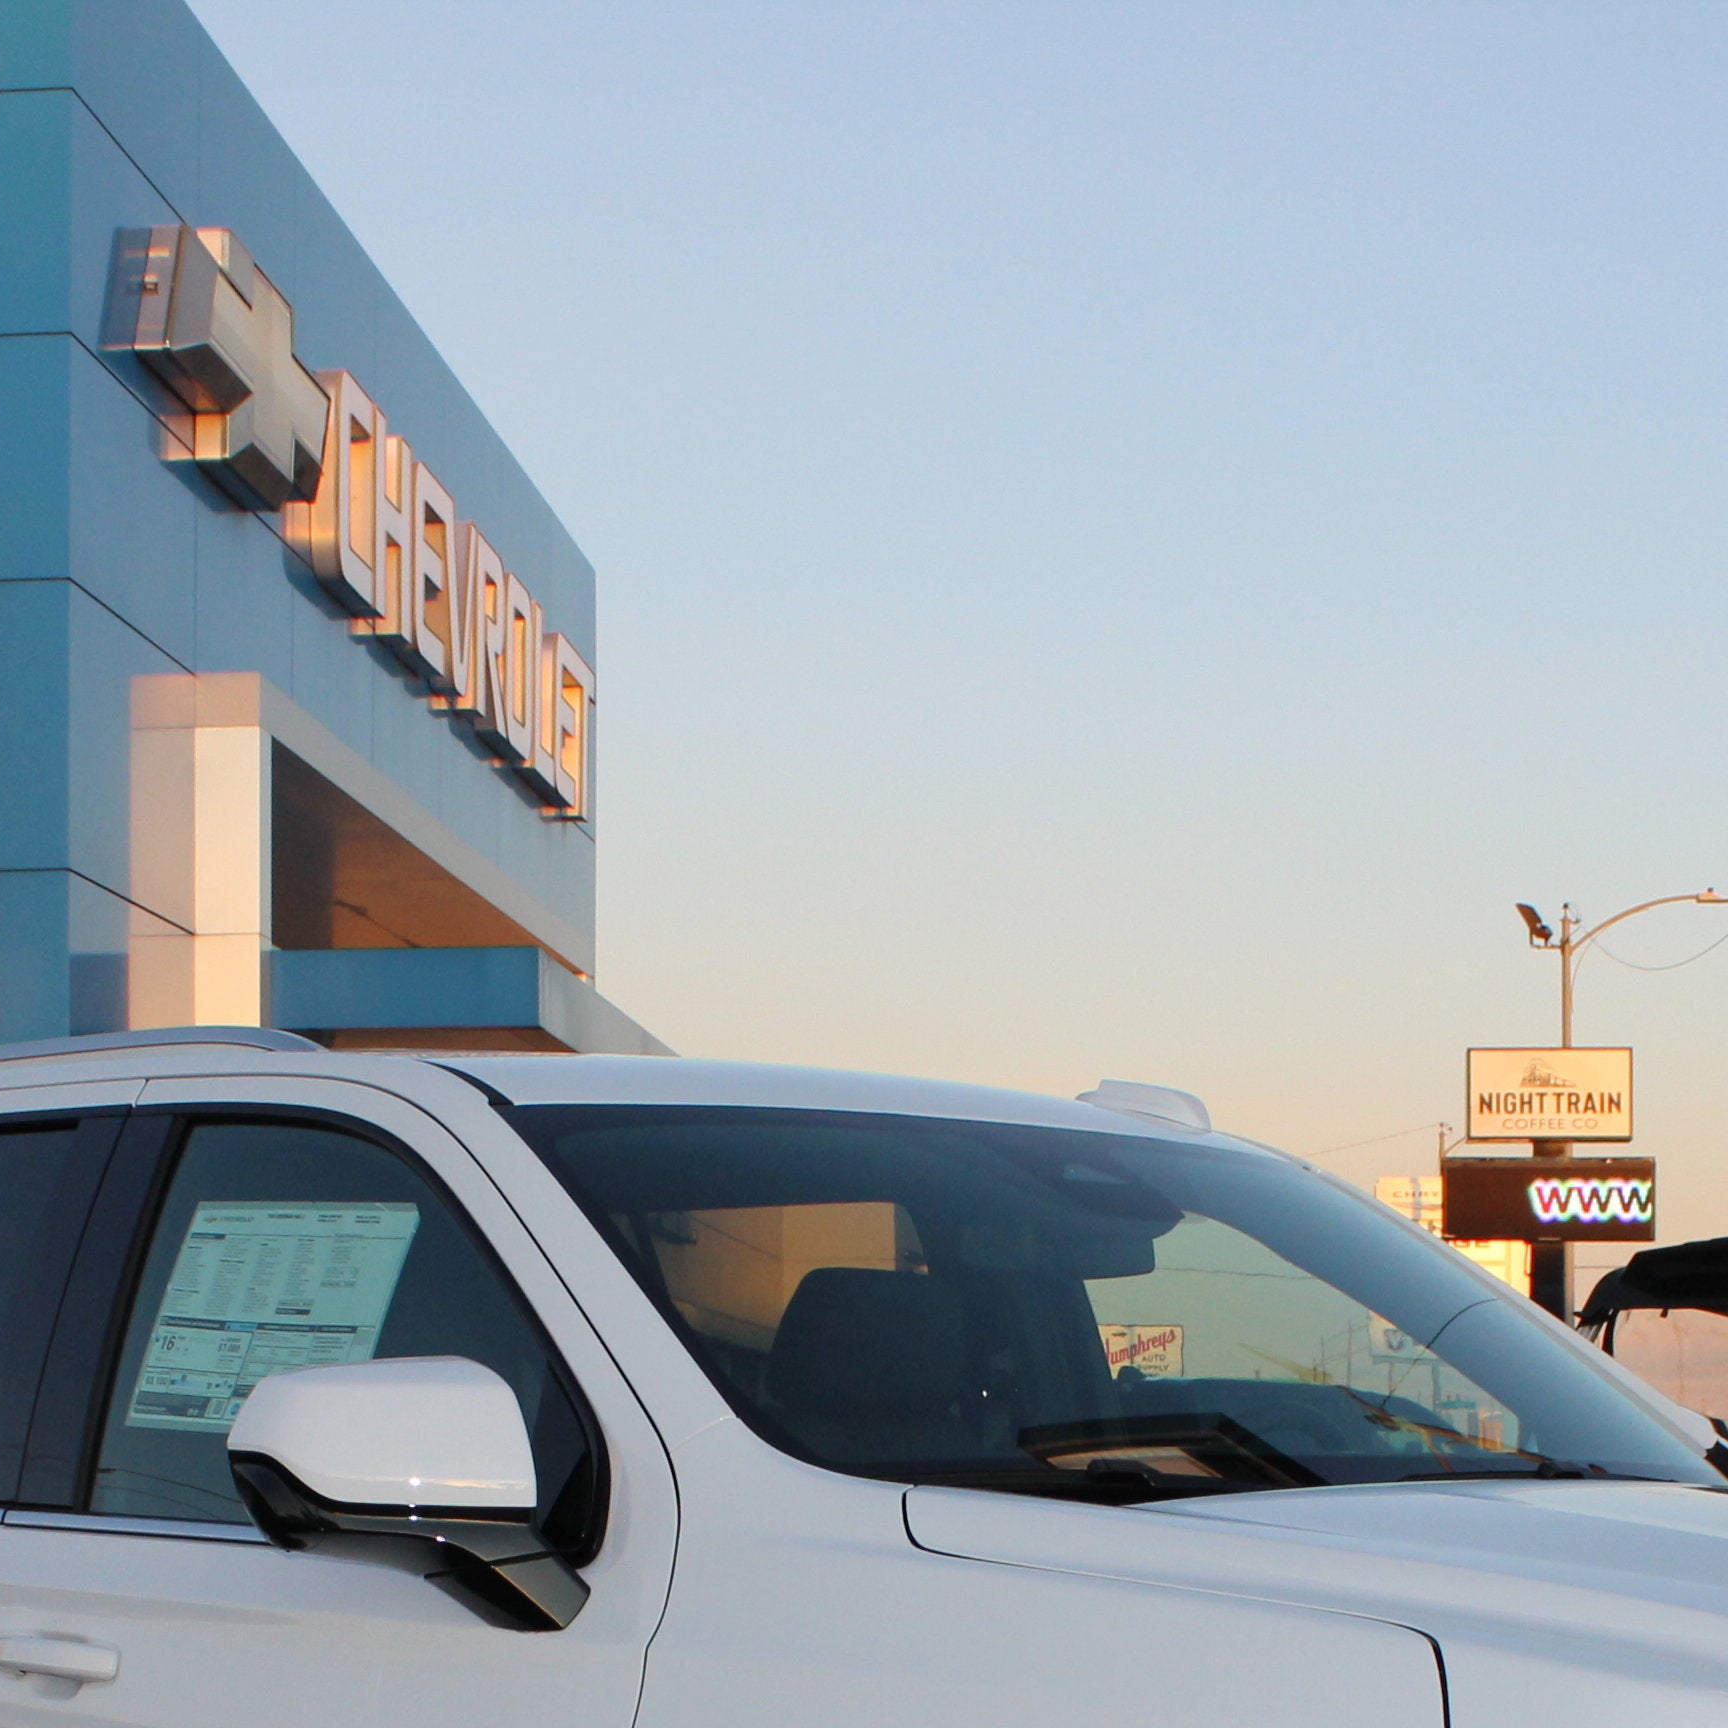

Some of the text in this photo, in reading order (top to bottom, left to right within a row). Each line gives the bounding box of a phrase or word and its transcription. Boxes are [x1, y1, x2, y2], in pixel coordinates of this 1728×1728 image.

[330, 369, 597, 822] CHEVROLET
[1478, 1091, 1622, 1115] NIGHT TRAIN
[1502, 1117, 1598, 1130] COFFEE CO
[1141, 1354, 1167, 1363] AUTO
